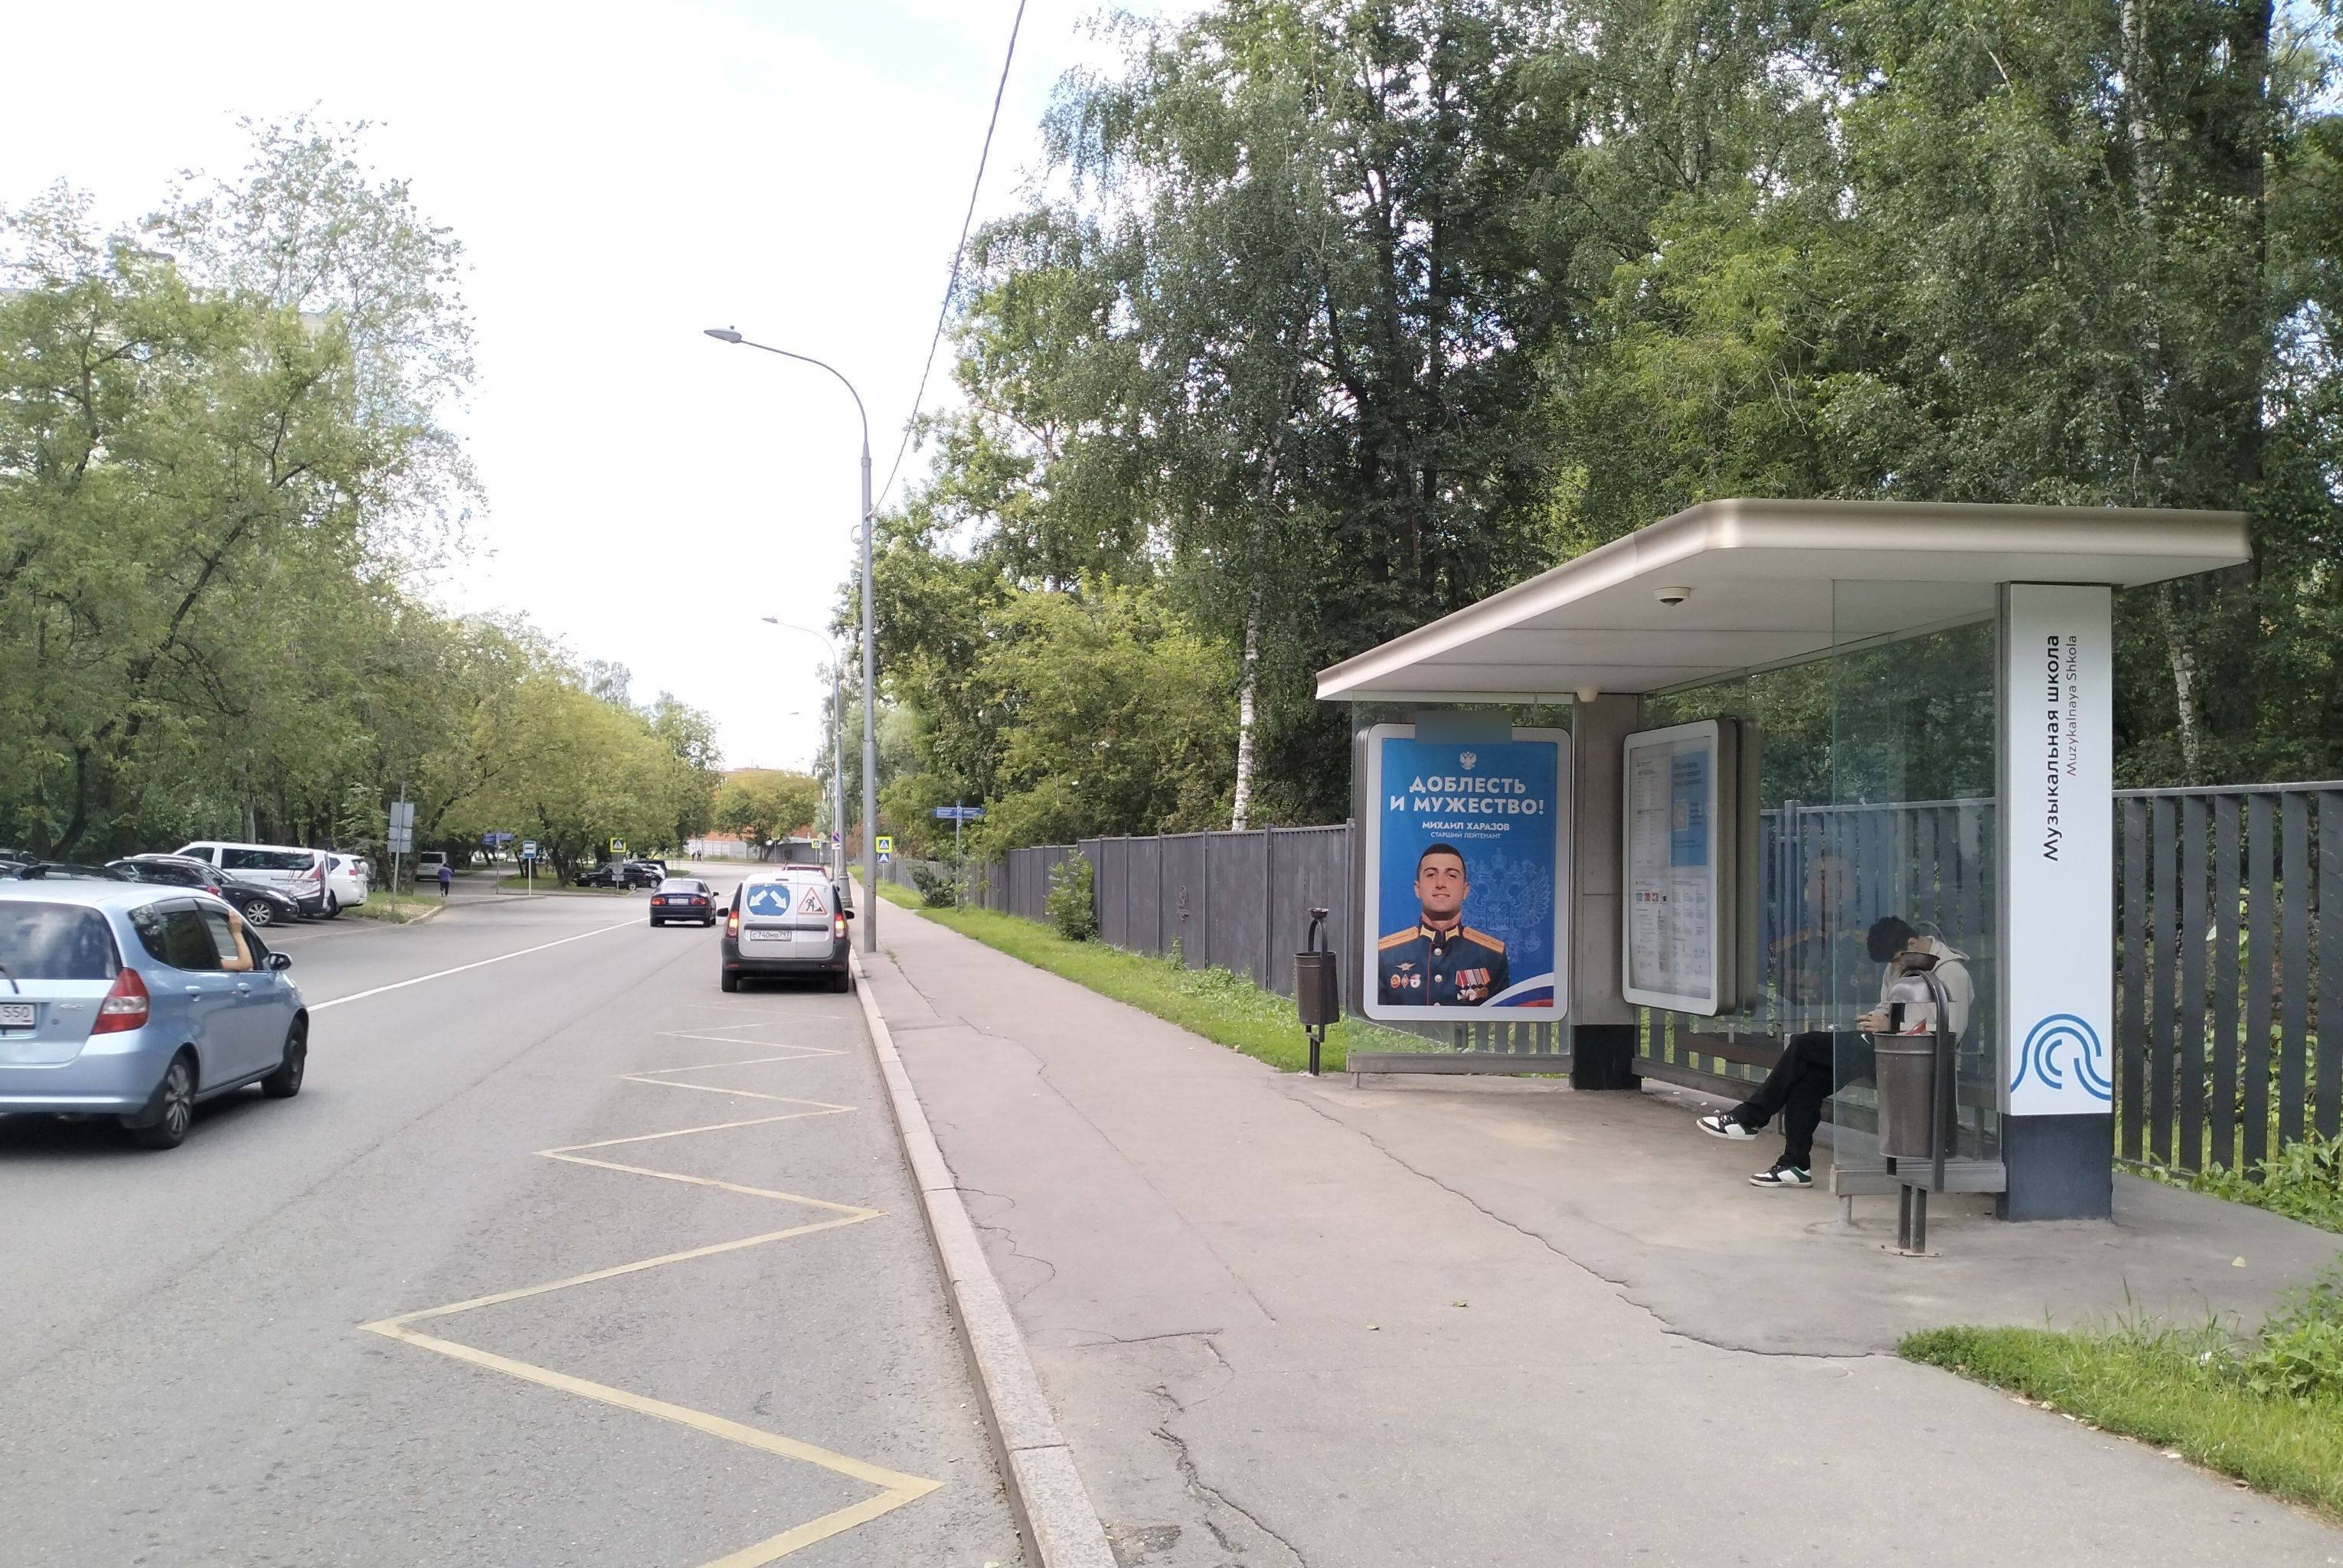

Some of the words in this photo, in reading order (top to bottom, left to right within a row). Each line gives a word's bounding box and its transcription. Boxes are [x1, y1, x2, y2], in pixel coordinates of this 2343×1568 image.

[2047, 635, 2060, 703] школа
[2066, 635, 2077, 681] Shkola
[2066, 685, 2079, 776] Muzykalnaya
[1409, 776, 1526, 794] ДОБЛЕСТЬ
[2043, 710, 2062, 861] Музыкальная
[1390, 795, 1406, 812] И
[1413, 796, 1544, 815] МУЖЕСТВО!
[1422, 821, 1464, 830] МИХАИЛ
[1466, 822, 1510, 831] ХАРАЗОВ
[1464, 831, 1502, 840] ЛЕЙТЕНАНТ
